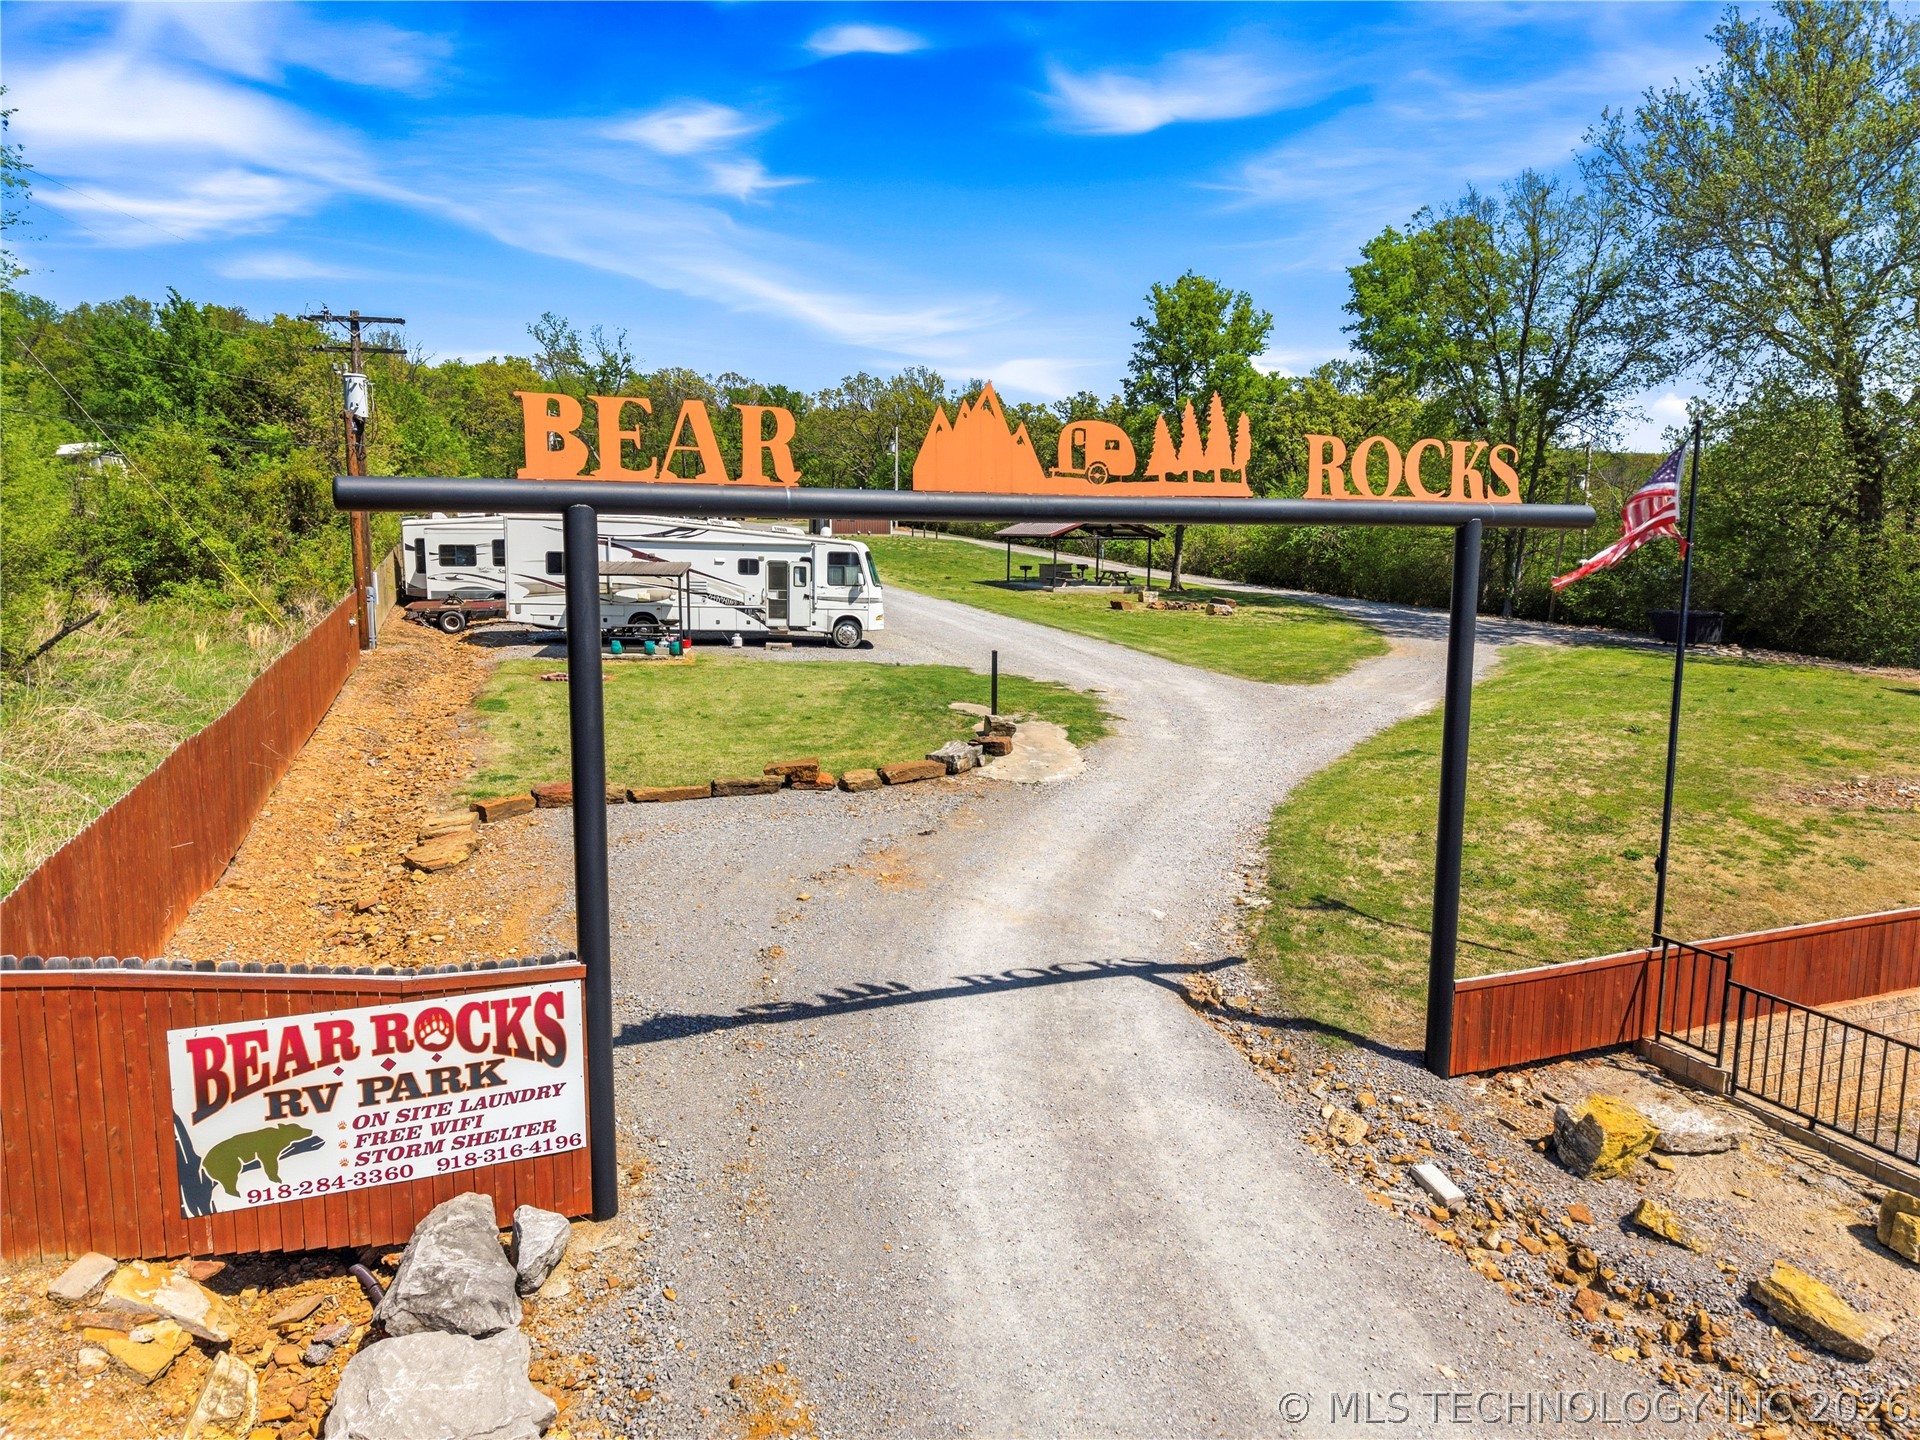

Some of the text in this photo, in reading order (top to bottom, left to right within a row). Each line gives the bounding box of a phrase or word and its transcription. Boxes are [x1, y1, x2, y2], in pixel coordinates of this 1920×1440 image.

[513, 391, 802, 486] BEAR
[1303, 434, 1522, 503] ROCKS
[186, 991, 567, 1126] BEAR ROCKS
[263, 1058, 507, 1121] RV PARK
[352, 1082, 566, 1131] ON SITE LAUNDRY
[354, 1115, 485, 1149] FREE WIFI
[354, 1119, 557, 1167] STORM SHELTER
[436, 1132, 582, 1172] 918-316-4196
[247, 1164, 414, 1204] 918-284-3360
